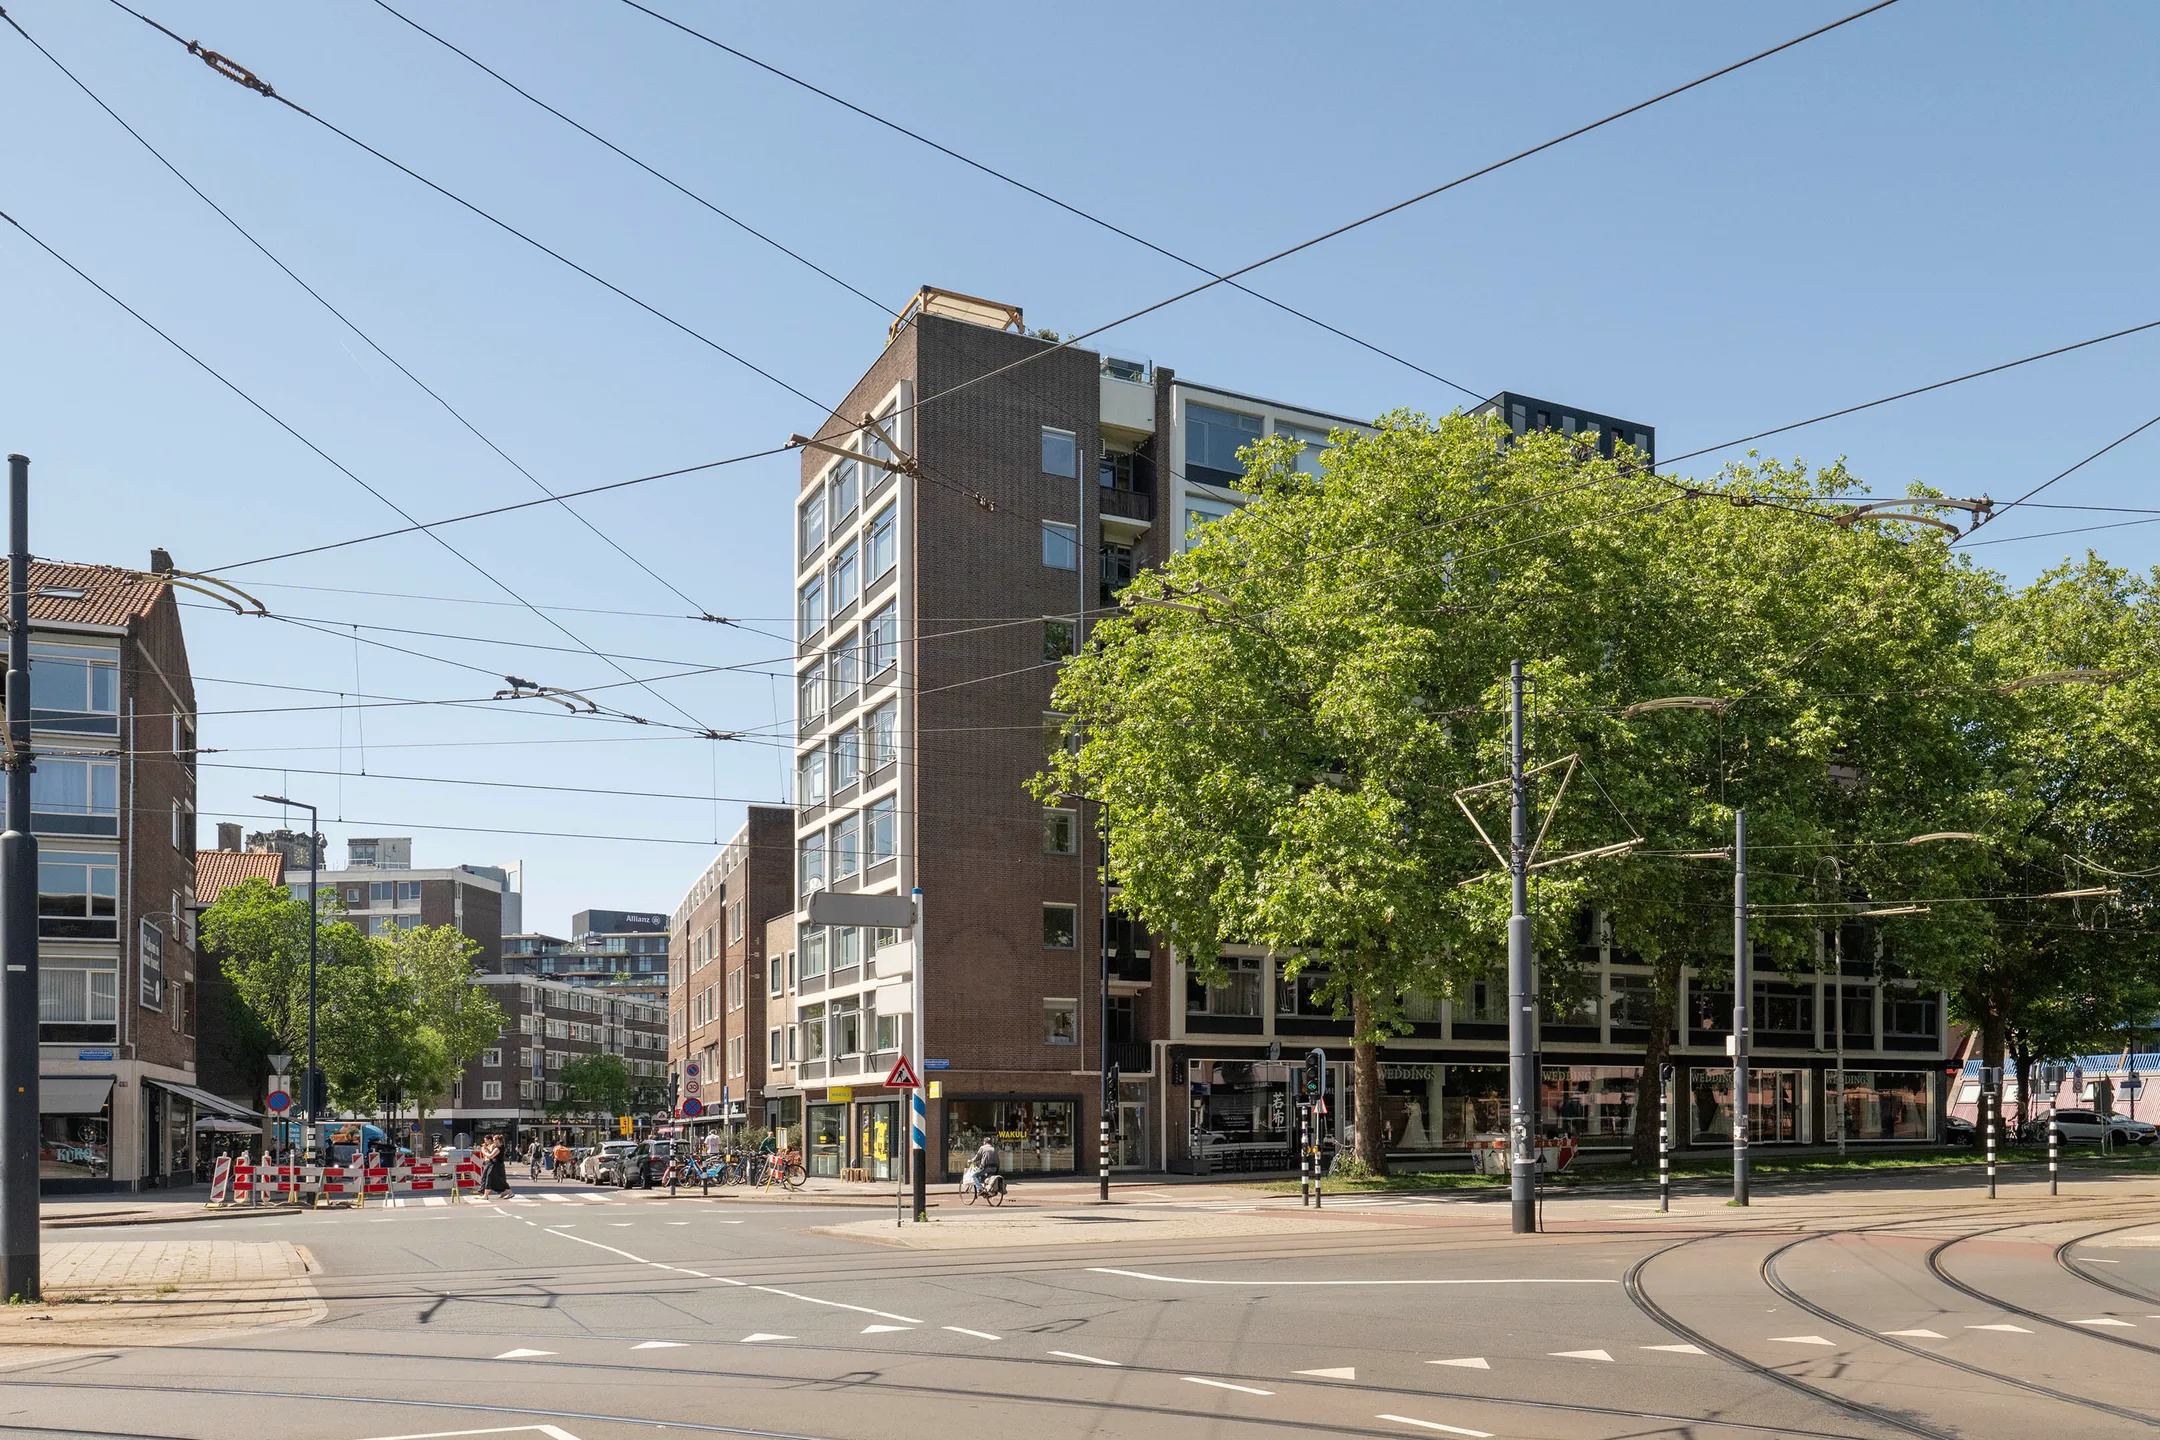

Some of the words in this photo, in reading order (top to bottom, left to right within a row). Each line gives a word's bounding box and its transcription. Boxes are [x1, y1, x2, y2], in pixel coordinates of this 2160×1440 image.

[626, 915, 650, 923] Allianz
[1376, 1068, 1436, 1080] WEDDINGS
[1543, 1071, 1595, 1082] WEDDINGS
[1691, 1072, 1734, 1083] WEDDING
[1826, 1075, 1869, 1085] WEDINGS
[998, 1130, 1027, 1139] WAKULI
